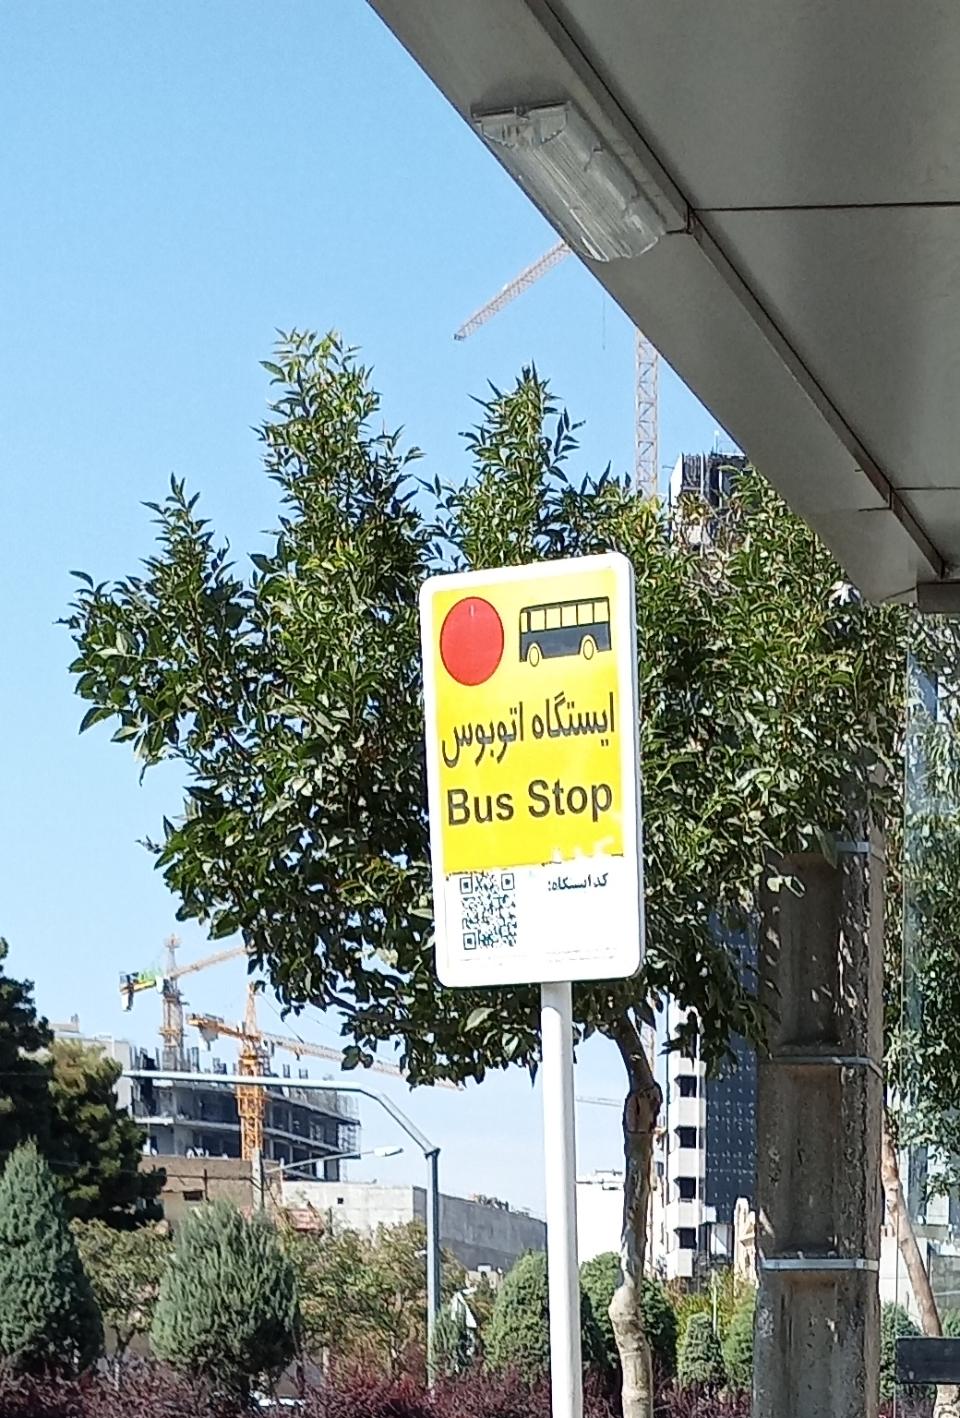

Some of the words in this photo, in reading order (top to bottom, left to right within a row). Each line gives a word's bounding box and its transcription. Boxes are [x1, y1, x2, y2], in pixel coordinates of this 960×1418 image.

[441, 701, 524, 768] اتوبوس
[532, 691, 615, 748] ایستگاه
[447, 788, 514, 826] Bus
[527, 778, 613, 823] Stop
